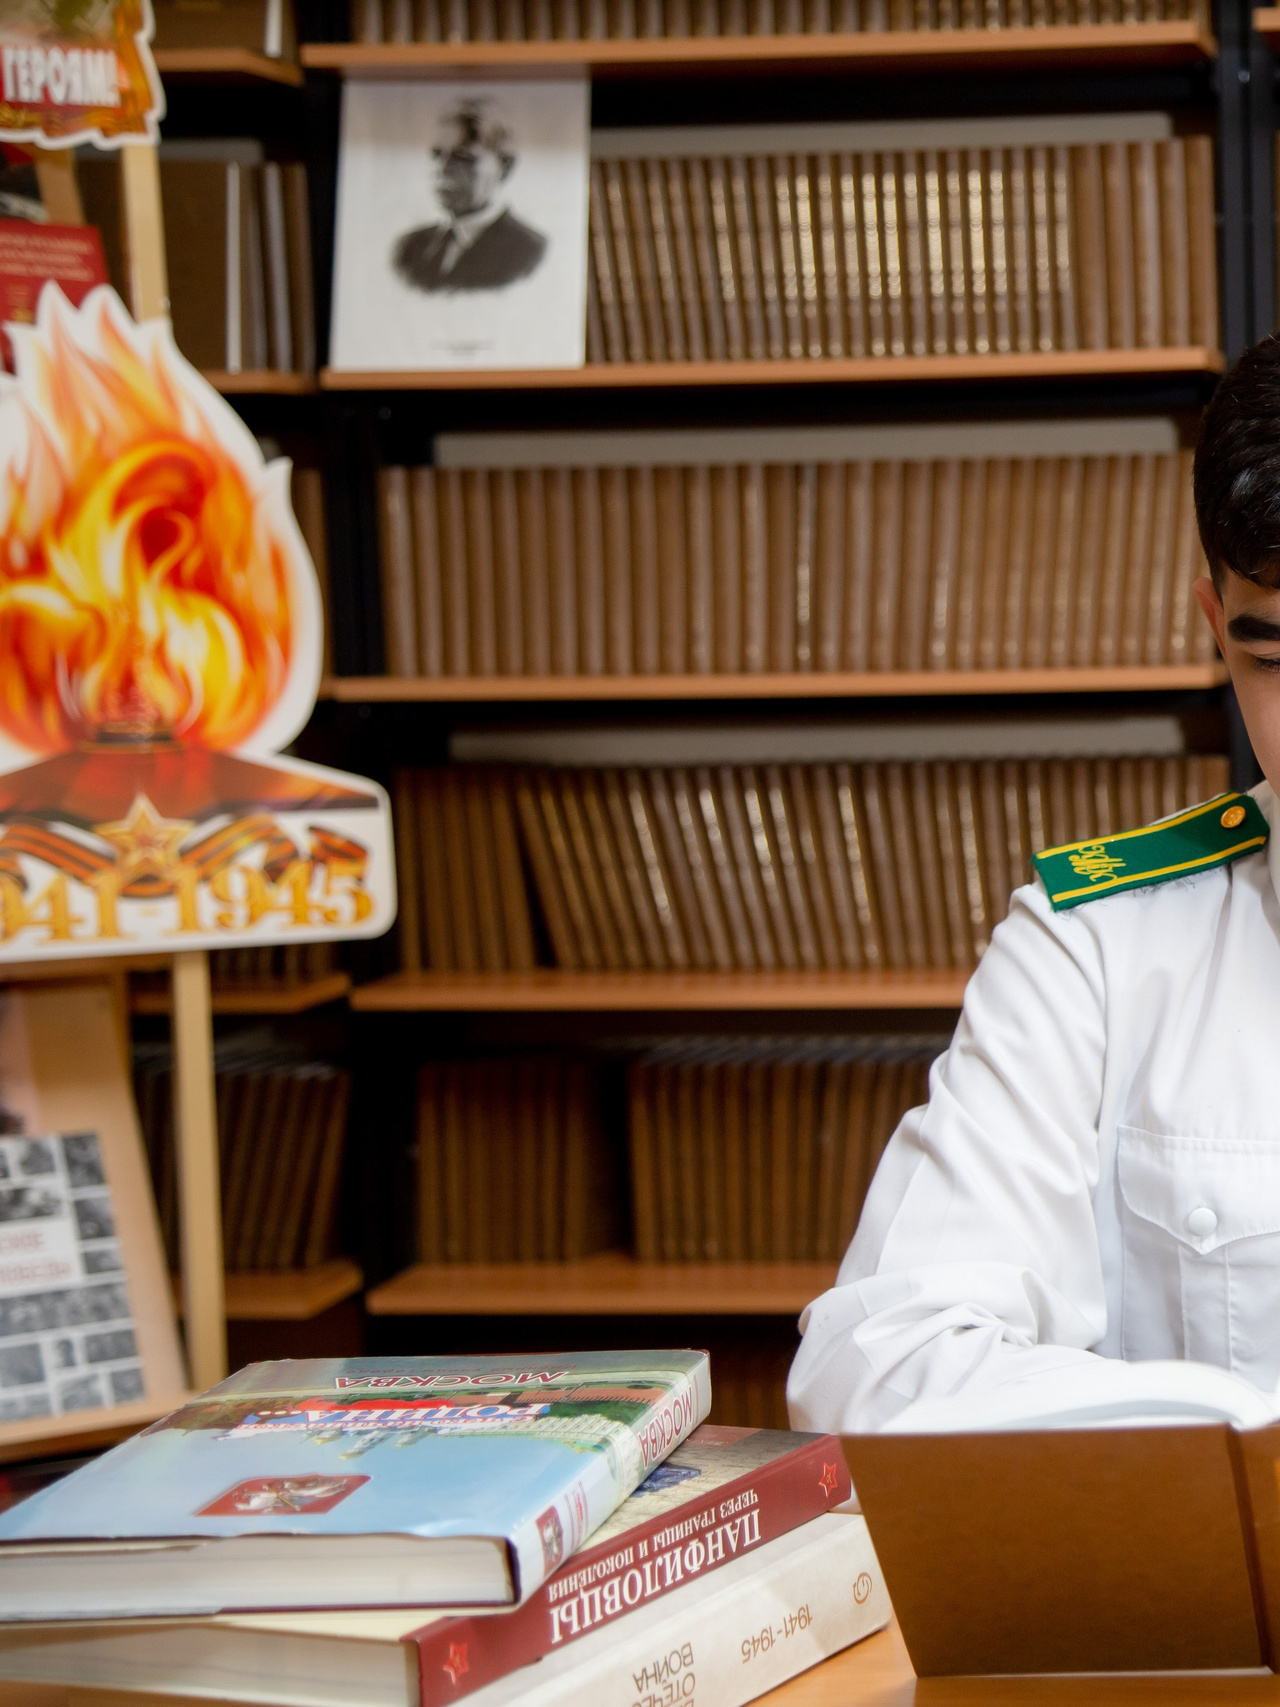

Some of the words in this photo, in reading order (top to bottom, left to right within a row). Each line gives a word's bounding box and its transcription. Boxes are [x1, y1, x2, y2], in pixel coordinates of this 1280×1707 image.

[0, 861, 376, 943] 41-1945
[335, 1371, 570, 1389] МОСКВА
[637, 1384, 693, 1470] МОСКВА
[653, 1507, 716, 1552] ГРАНИЦЫ
[720, 1489, 758, 1519] ЧЕРЕЗ
[638, 1539, 650, 1560] И
[549, 1551, 634, 1604] ПОКОЛЕНИЯ
[551, 1509, 762, 1645] ПАНФИЛОВЦЫ
[632, 1642, 695, 1693] ВОЙНА
